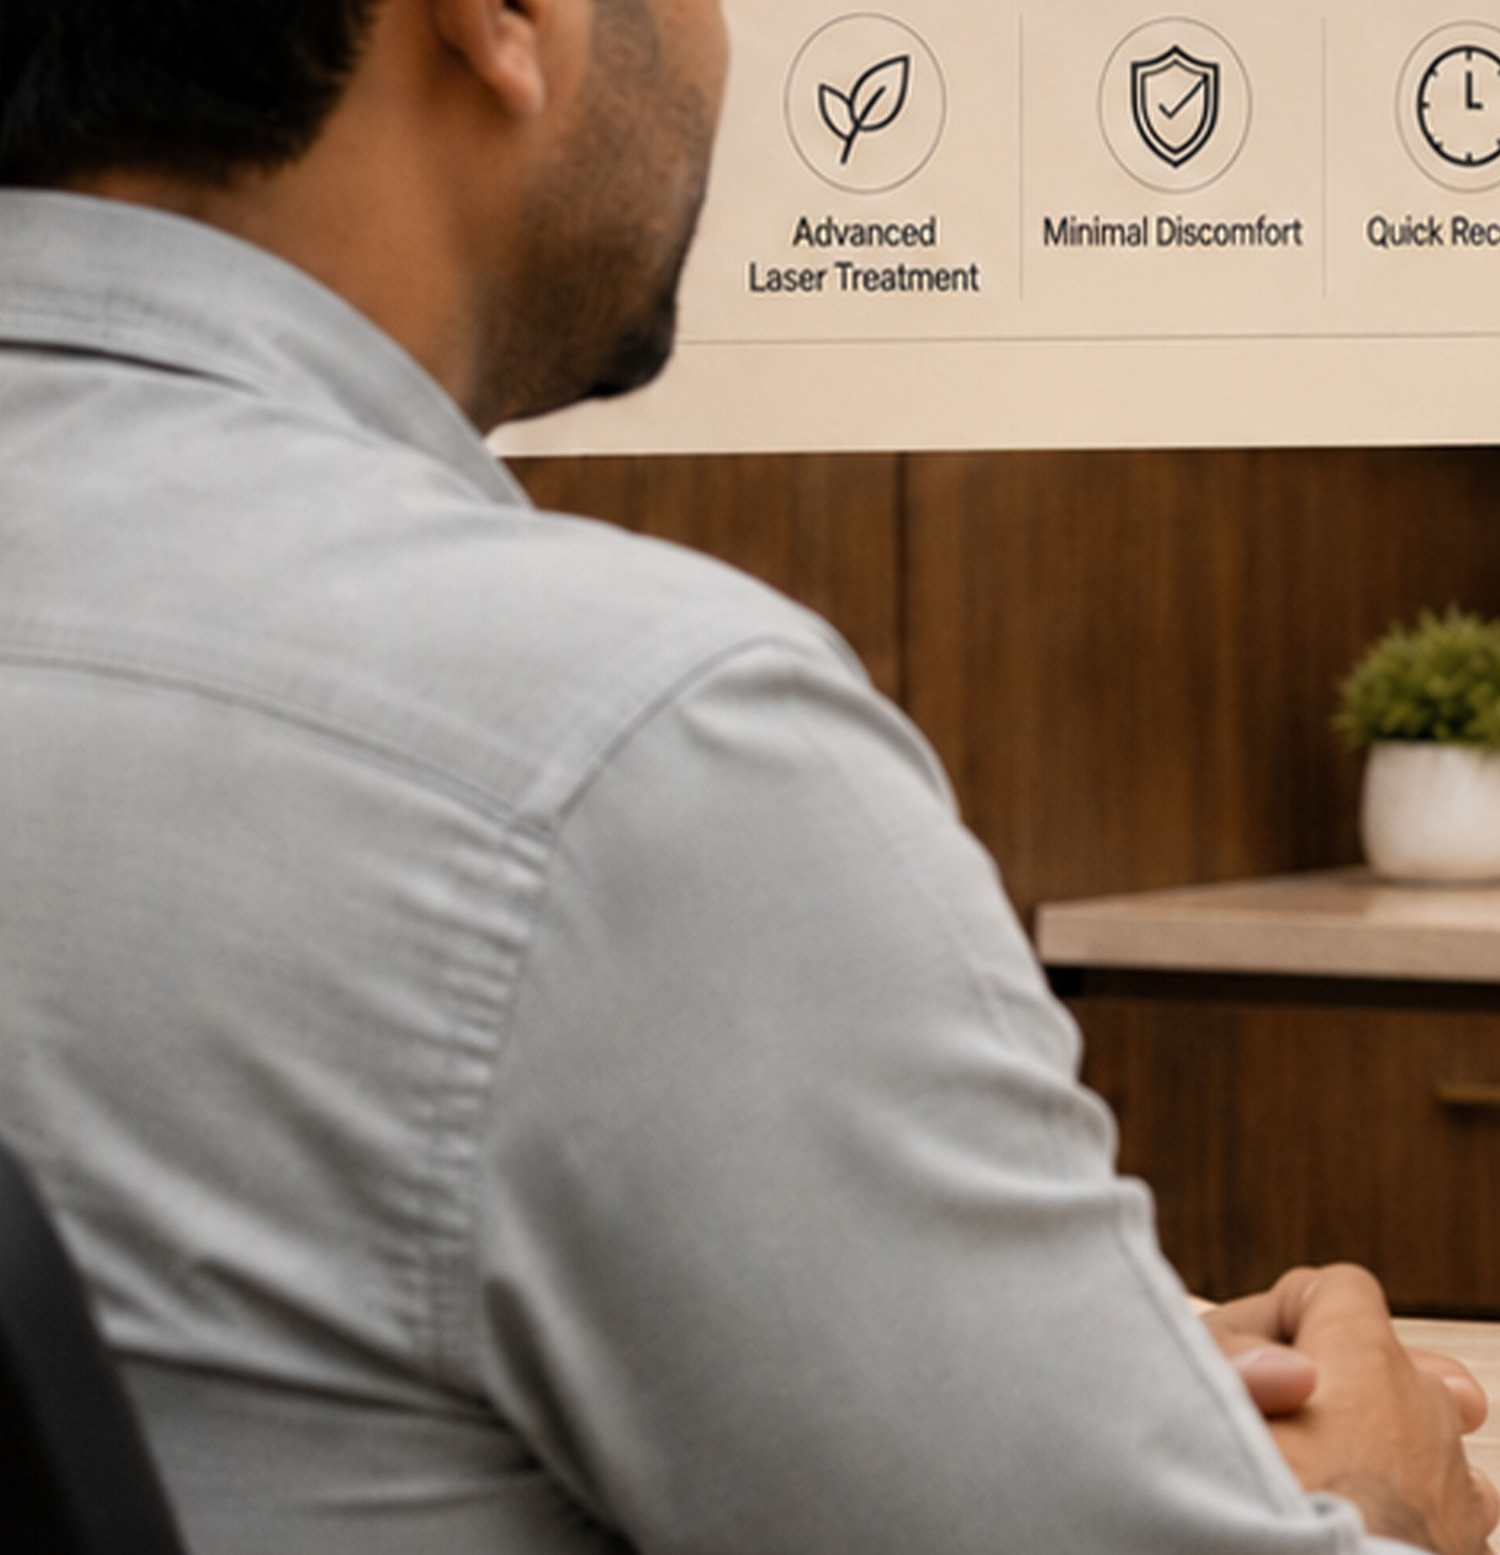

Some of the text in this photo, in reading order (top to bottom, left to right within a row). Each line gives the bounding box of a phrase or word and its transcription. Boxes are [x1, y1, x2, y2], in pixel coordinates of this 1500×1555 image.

[792, 216, 936, 248] Advanced
[1043, 215, 1302, 247] Minimal Discomfort
[1367, 215, 1443, 249] Quick
[749, 261, 979, 293] Laser Treatment
